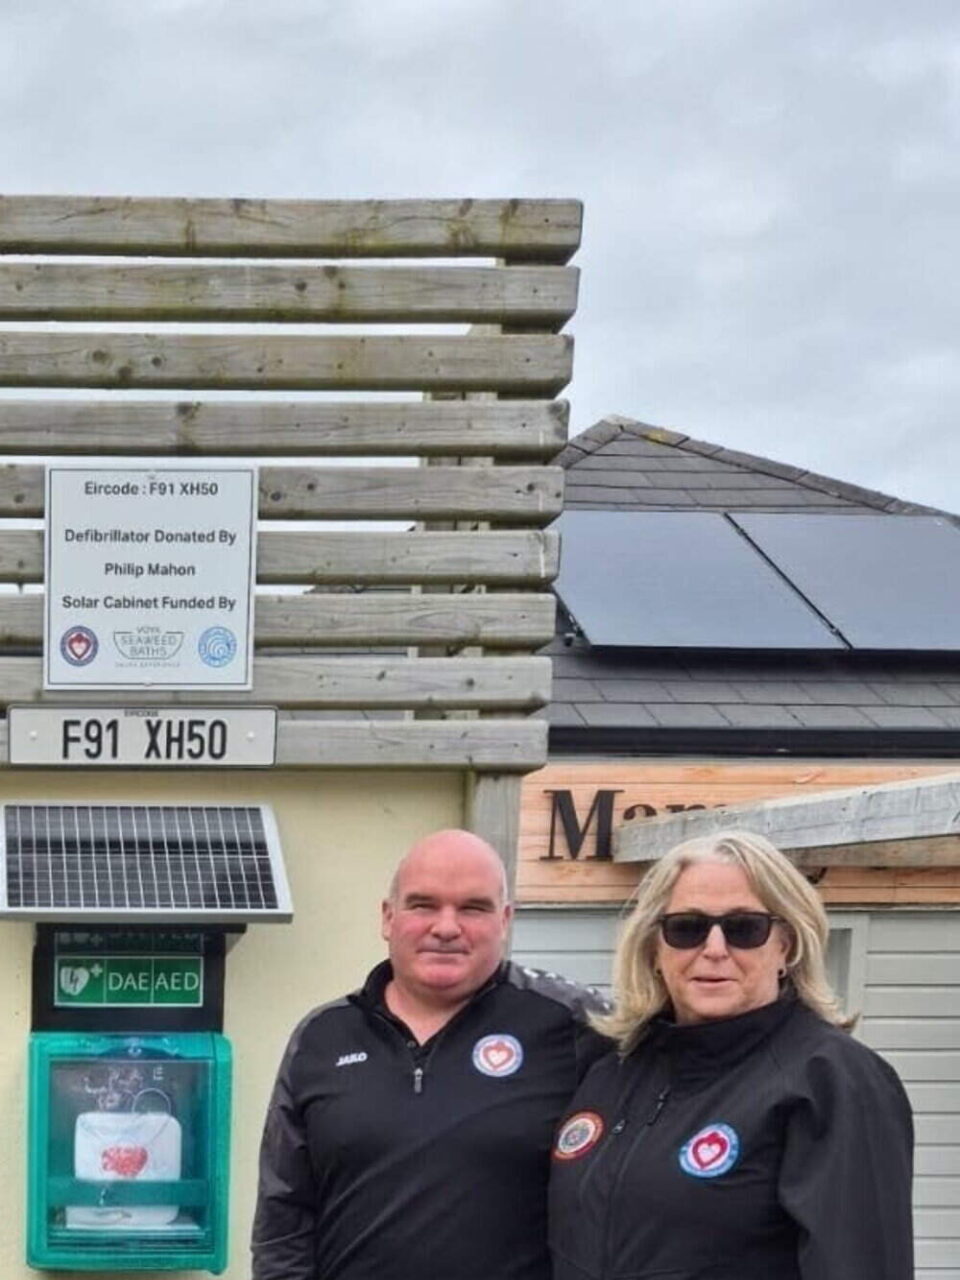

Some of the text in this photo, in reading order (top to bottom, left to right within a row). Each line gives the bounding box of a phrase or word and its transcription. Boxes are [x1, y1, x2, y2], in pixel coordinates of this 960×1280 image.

[84, 480, 139, 496] Eircode
[149, 481, 175, 496] F91
[179, 482, 219, 496] XH50
[64, 528, 237, 547] Defibrillator Donated By
[104, 562, 196, 579] Philip Mahon
[61, 595, 237, 612] Solar Cabinet Funded By
[121, 635, 177, 646] SEAWEED
[129, 646, 168, 657] BATHS
[62, 719, 228, 761] F91 XH50
[108, 972, 199, 991] DAE AED
